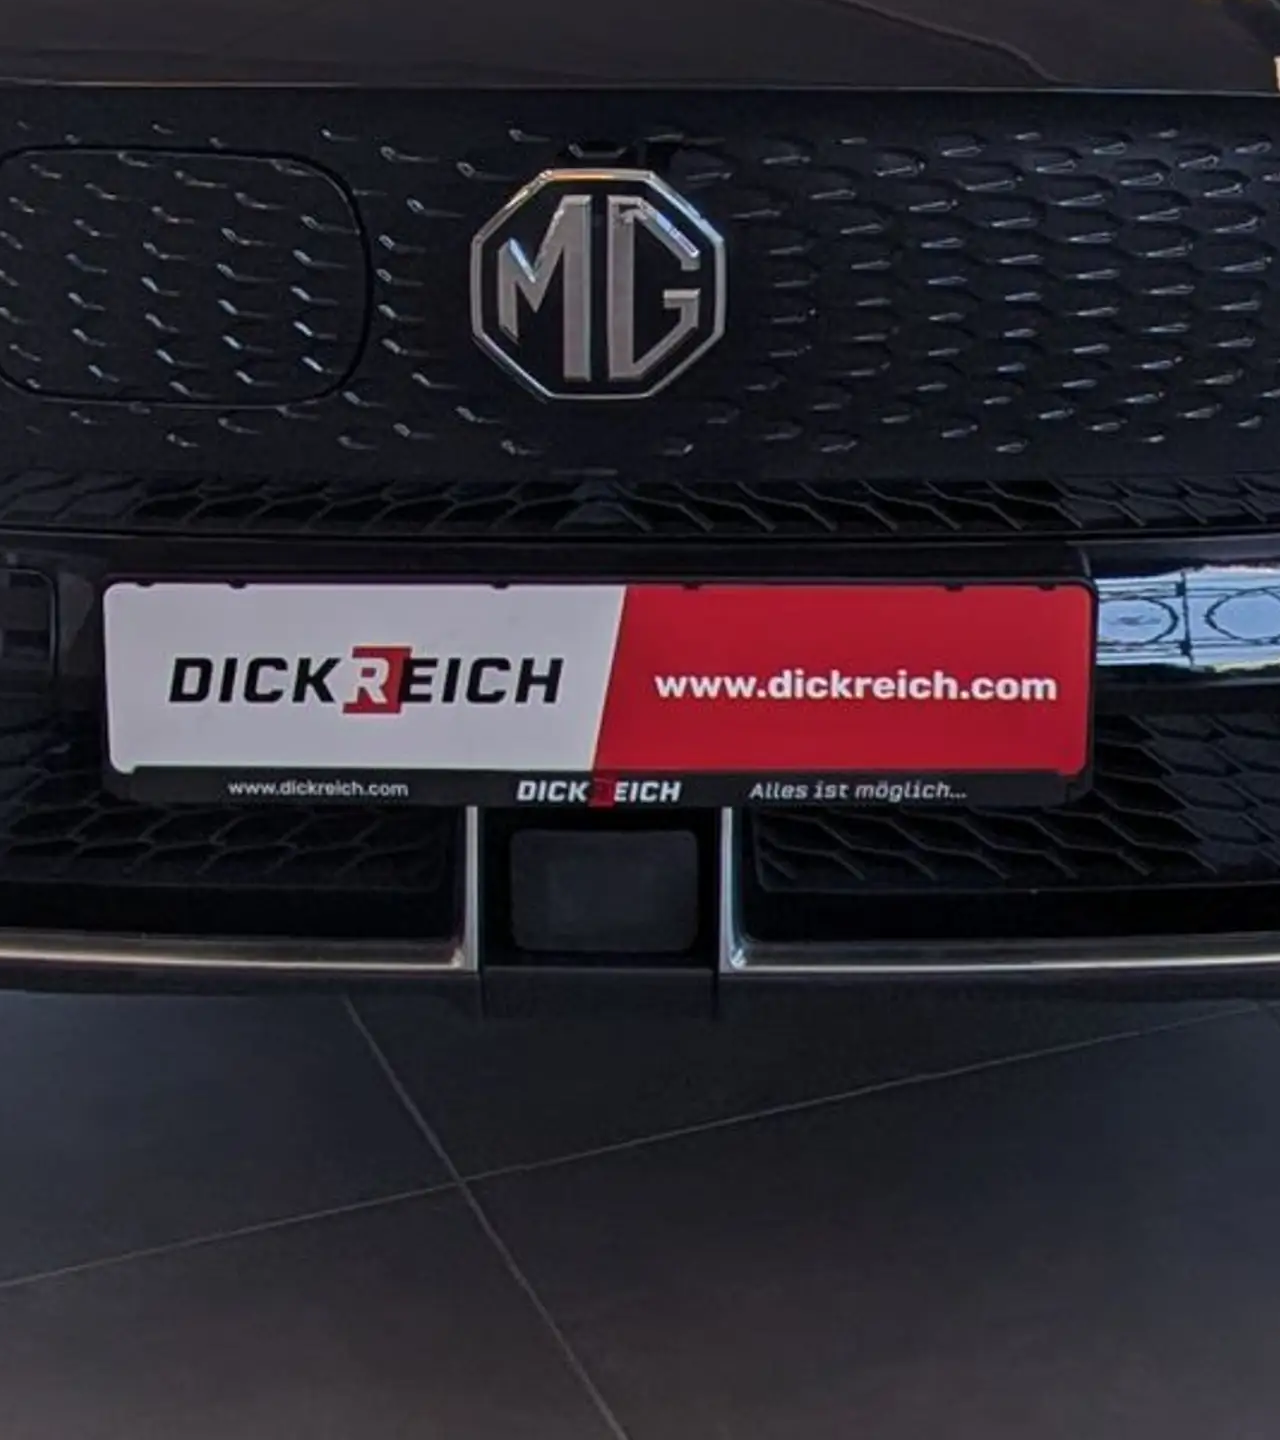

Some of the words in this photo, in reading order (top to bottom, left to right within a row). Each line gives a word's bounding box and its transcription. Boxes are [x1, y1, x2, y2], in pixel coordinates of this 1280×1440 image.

[497, 193, 701, 383] MG
[168, 656, 564, 705] DICKREICH
[654, 668, 1058, 701] www.dickreich.com
[227, 779, 410, 798] www.dickreich.com
[516, 779, 683, 804] DICKEICH
[748, 781, 808, 800] Alles
[814, 781, 849, 800] ist
[854, 781, 969, 804] möglich...
